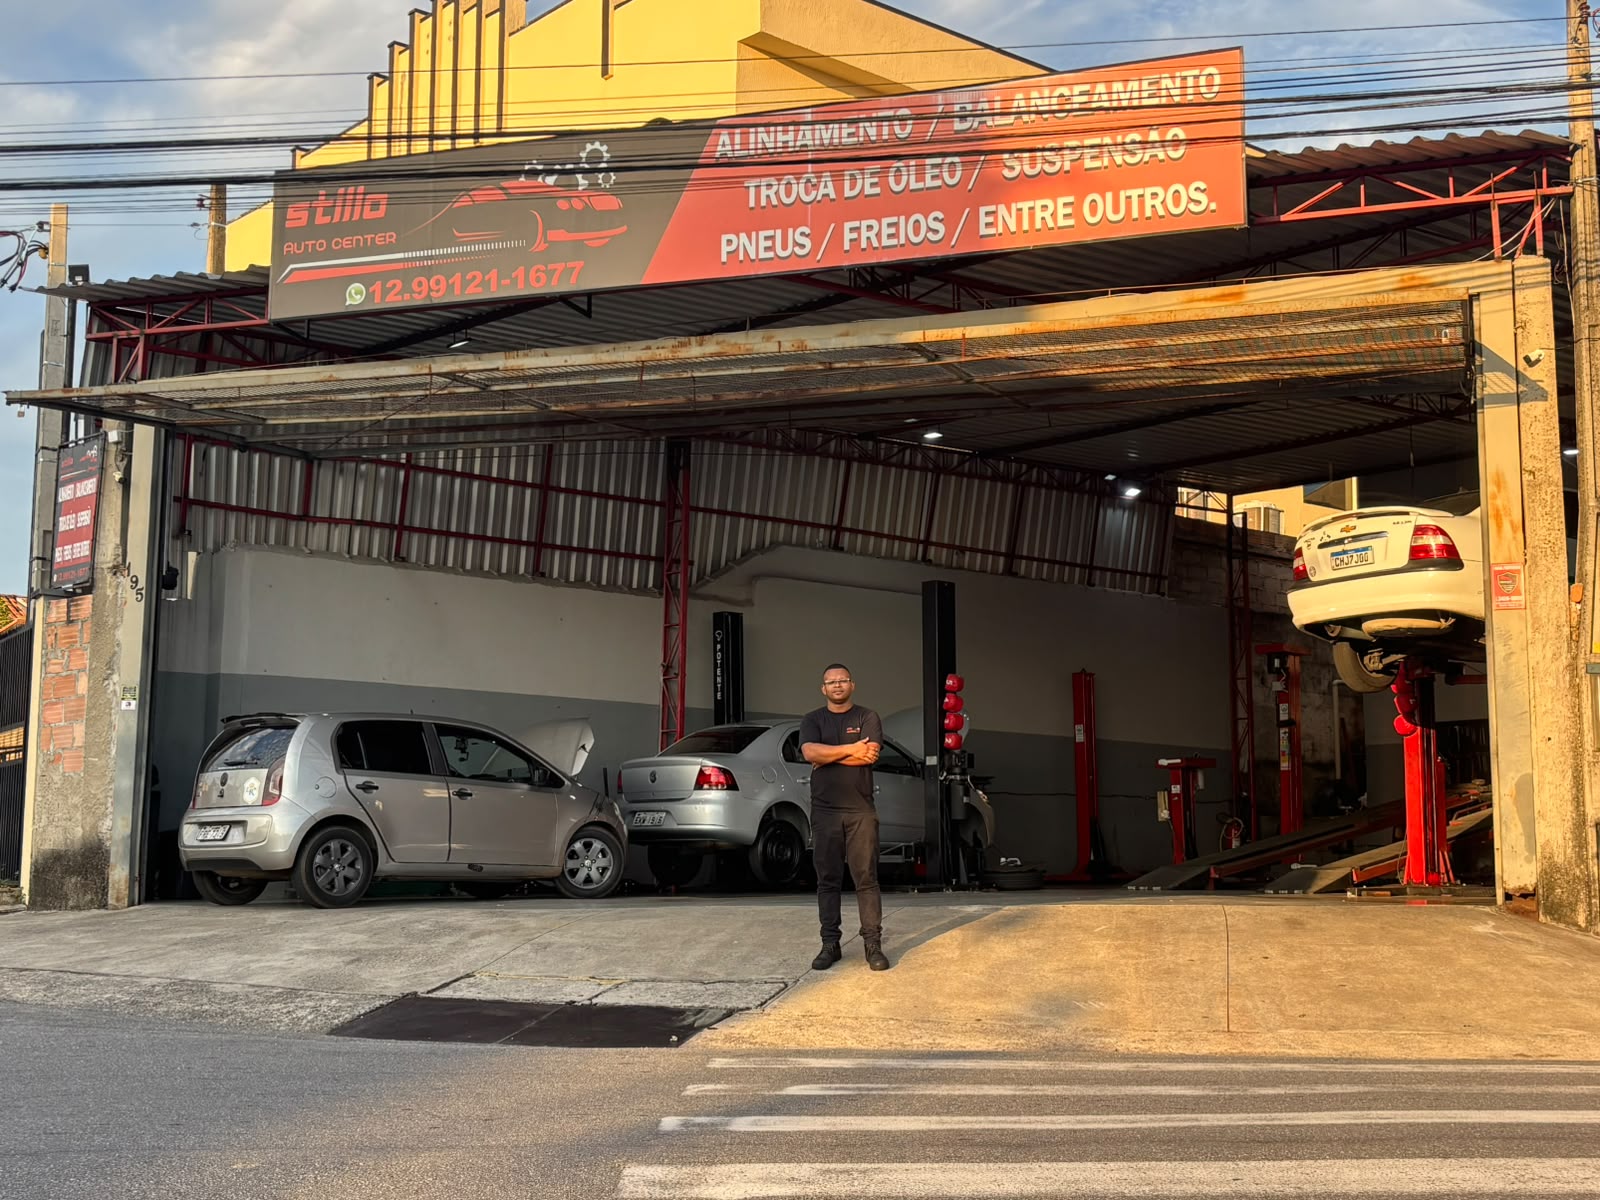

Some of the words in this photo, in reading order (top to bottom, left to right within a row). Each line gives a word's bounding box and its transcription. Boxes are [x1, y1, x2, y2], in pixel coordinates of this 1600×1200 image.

[715, 107, 914, 161] ALINHAMENTO
[953, 66, 1222, 133] BALANCEAMENTO
[744, 171, 837, 208] TROCA
[844, 165, 882, 198] DE
[283, 239, 327, 256] AUTO
[331, 231, 397, 250] CENTER
[720, 226, 812, 263] PNEUS
[816, 223, 836, 262] /
[843, 210, 946, 251] FREIOS
[950, 207, 970, 247] /
[978, 195, 1075, 239] ENTRE
[1082, 180, 1217, 226] OUTROS.
[368, 260, 585, 304] 12.99121-1677
